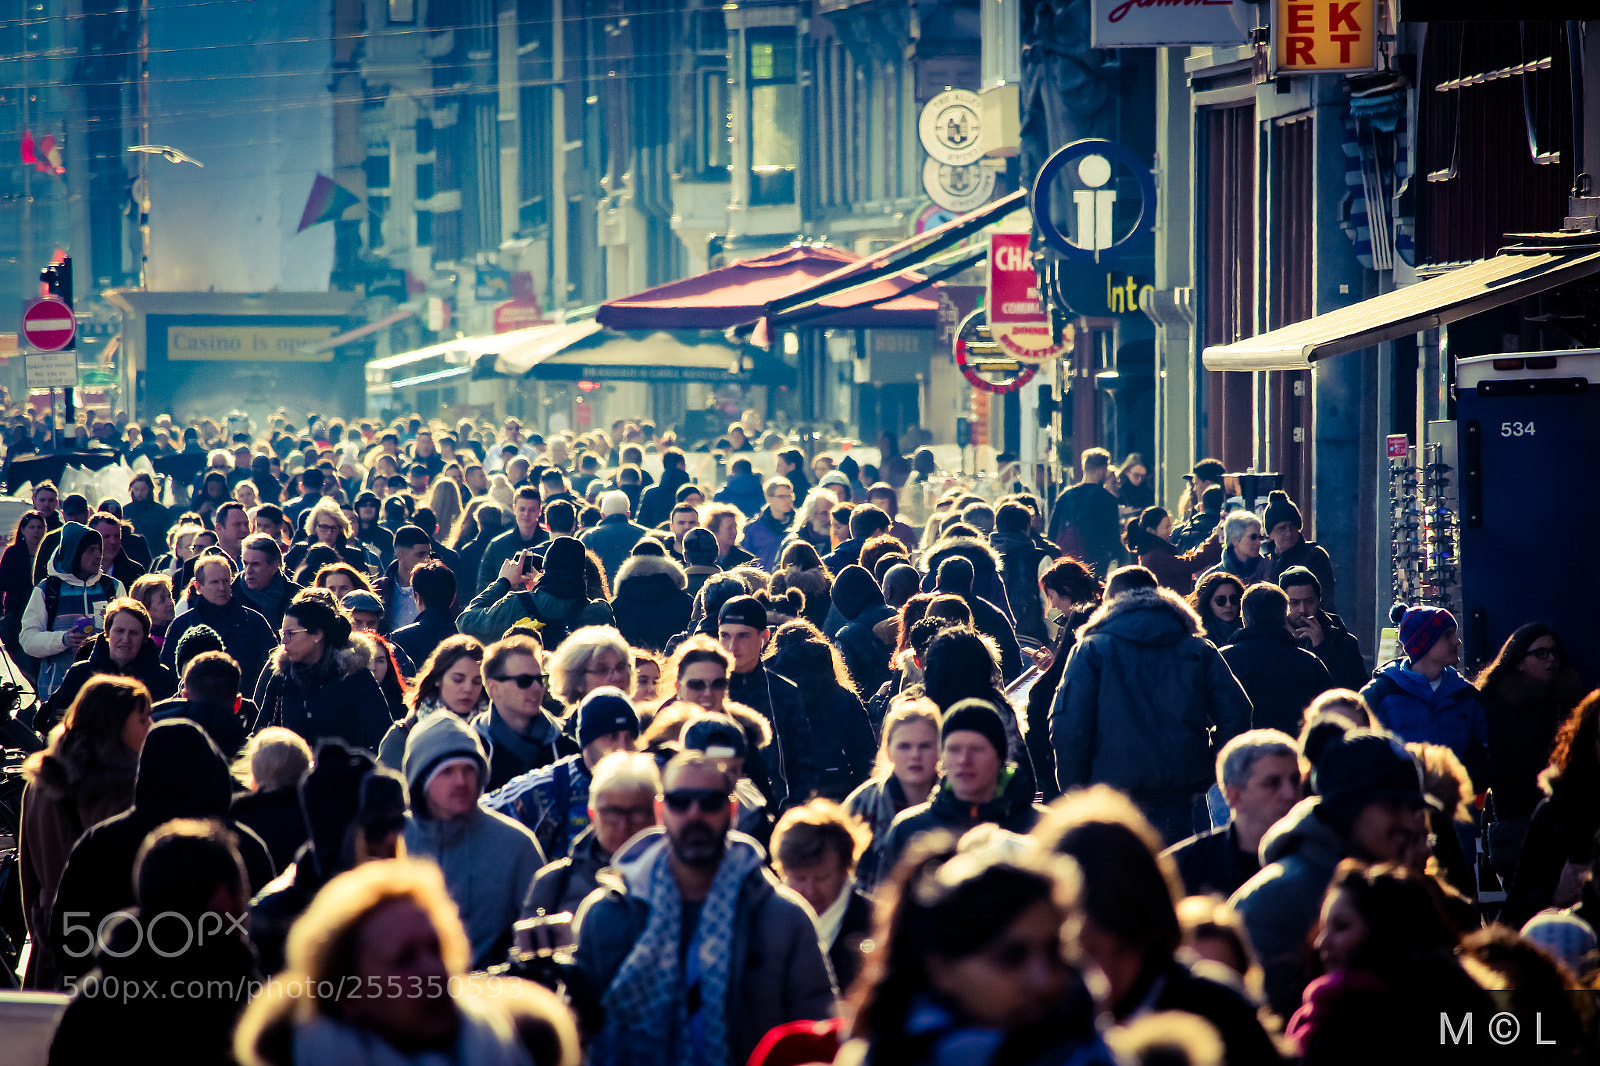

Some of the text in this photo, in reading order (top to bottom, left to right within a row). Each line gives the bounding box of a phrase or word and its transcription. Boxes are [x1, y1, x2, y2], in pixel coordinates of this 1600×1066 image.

[995, 246, 1035, 271] CHA
[173, 333, 320, 355] Casino is ope
[1500, 421, 1536, 437] 534
